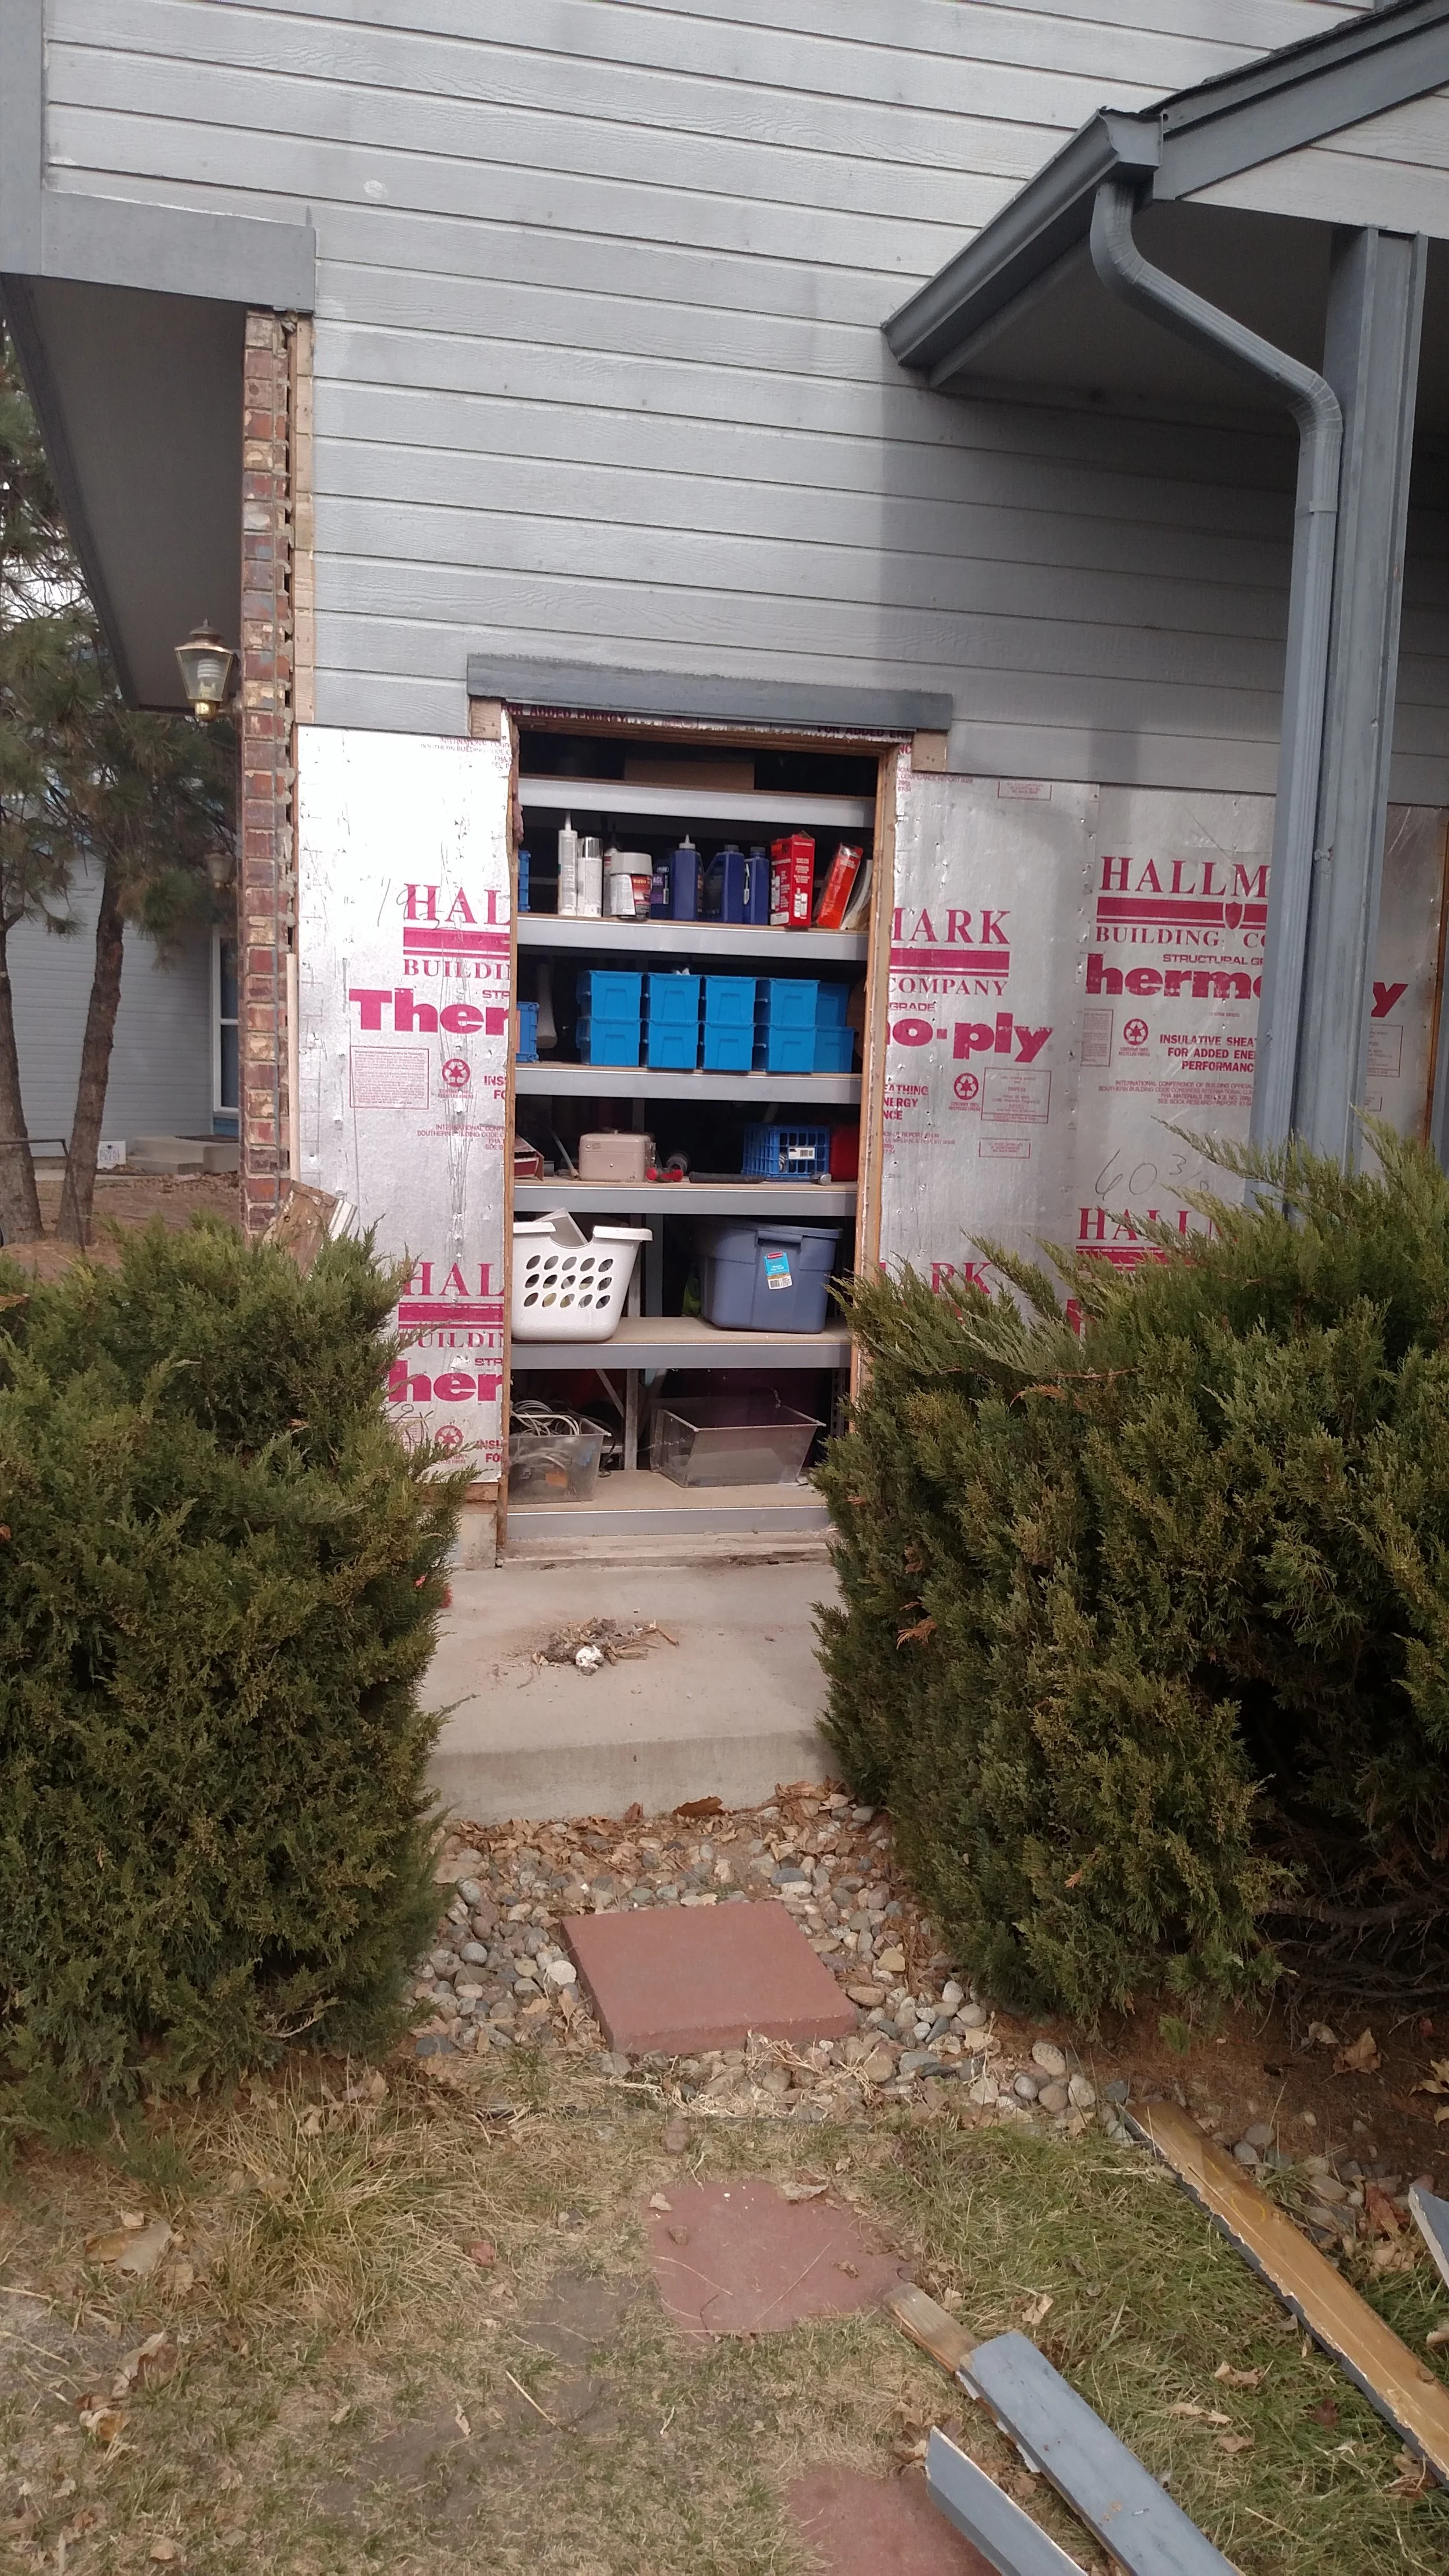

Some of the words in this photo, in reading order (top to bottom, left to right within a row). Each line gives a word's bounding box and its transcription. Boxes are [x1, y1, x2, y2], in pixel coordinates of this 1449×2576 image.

[1095, 926, 1219, 947] BUILDING
[1163, 954, 1248, 966] STRUCTURAL
[1085, 952, 1262, 1000] herm
[348, 987, 509, 1036] Ther
[889, 1002, 935, 1012] GRADE
[1159, 1034, 1222, 1046] INSULATIVE
[1167, 1047, 1189, 1057] FOR
[1193, 1048, 1229, 1059] ADDED
[1181, 1060, 1254, 1073] PERFORMANC
[484, 1075, 506, 1086] INS
[485, 1453, 502, 1463] FO
